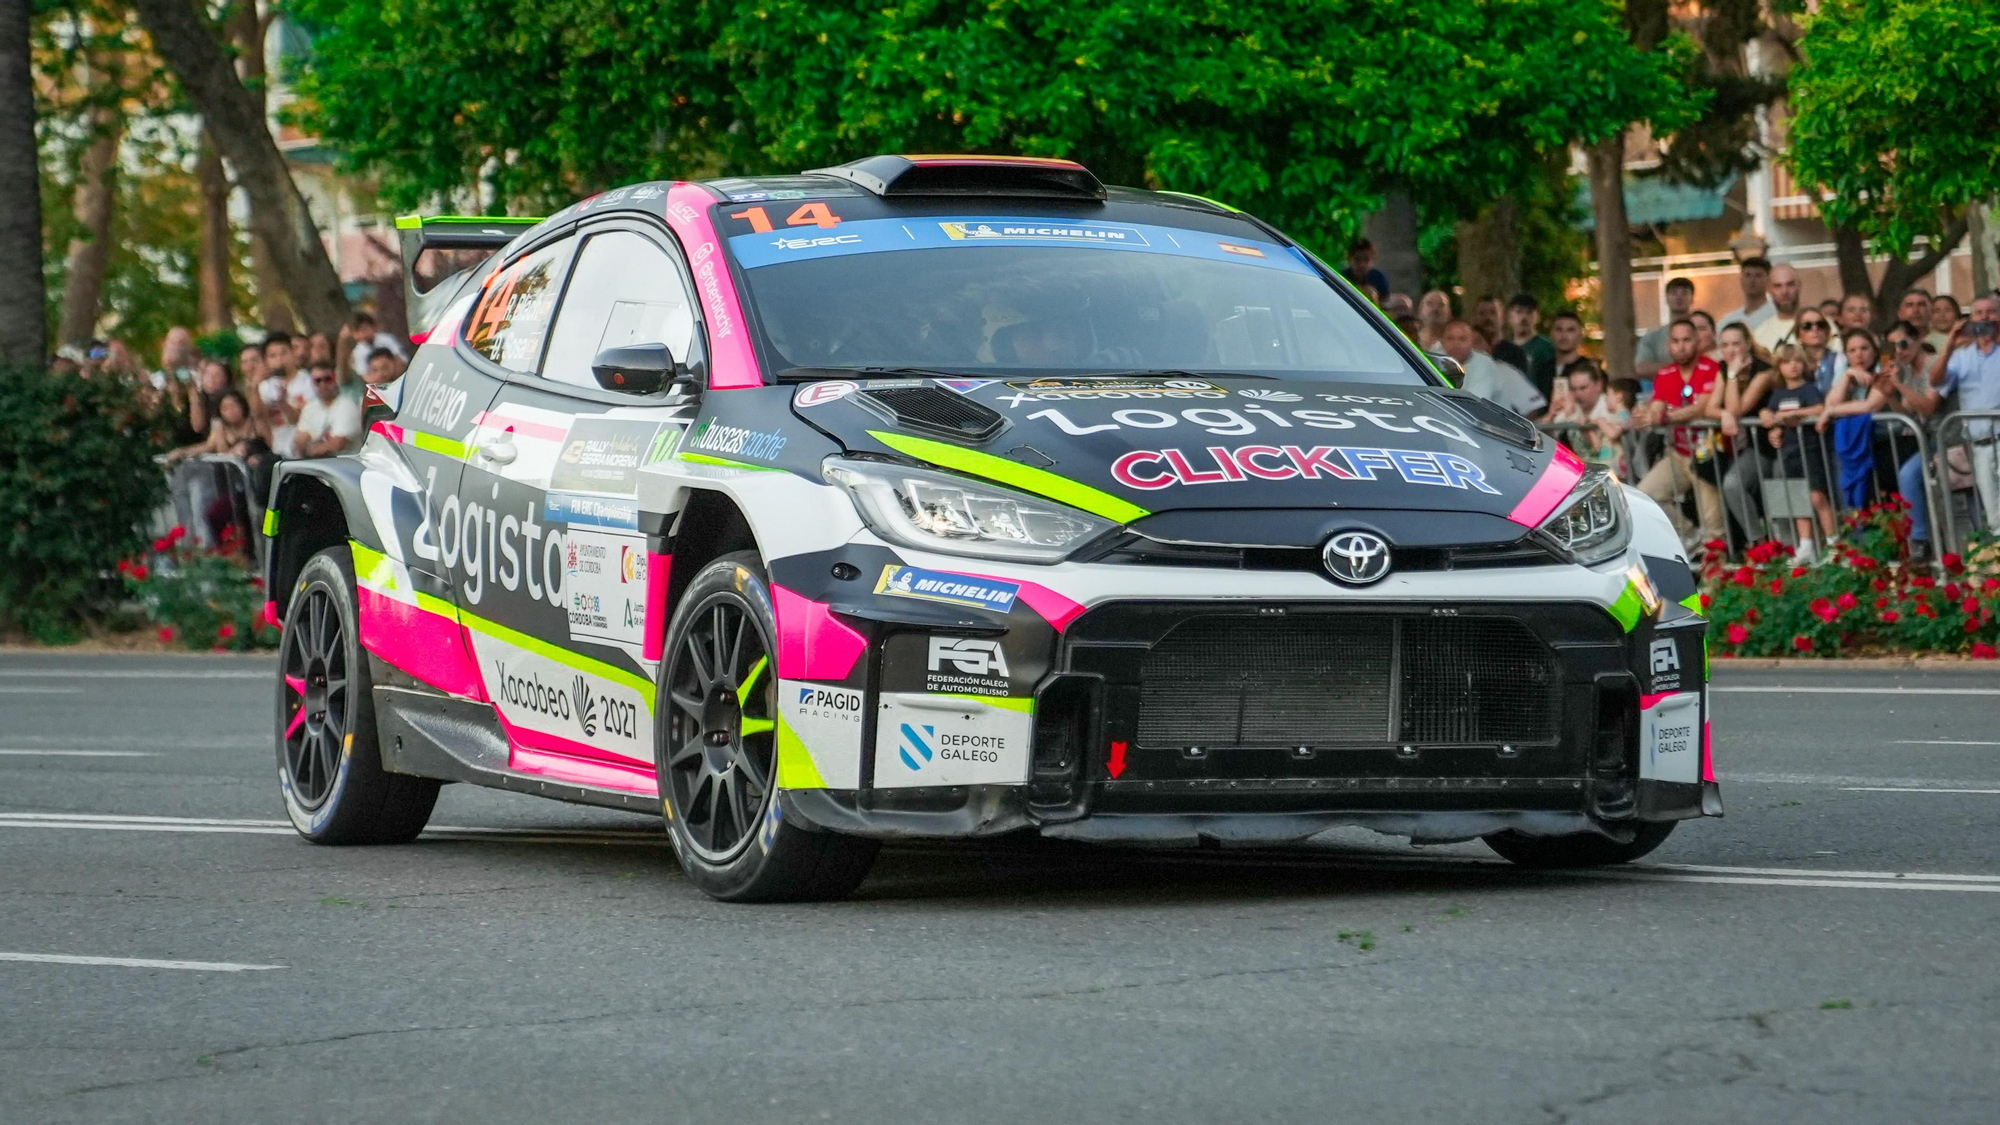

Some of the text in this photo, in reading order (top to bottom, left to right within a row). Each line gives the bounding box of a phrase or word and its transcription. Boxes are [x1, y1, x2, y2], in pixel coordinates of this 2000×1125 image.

[731, 203, 842, 233] 14
[1004, 227, 1125, 239] MICHELIN
[786, 234, 862, 250] ERC
[465, 255, 529, 341] 14
[405, 363, 467, 431] Arteixo
[809, 385, 844, 402] E
[996, 391, 1227, 409] Xacobeo
[584, 440, 610, 453] RALLY
[1110, 445, 1503, 496] CLICKFER
[914, 578, 1014, 604] MICHELIN
[926, 636, 1010, 678] FGA
[927, 674, 1009, 689] FEDERACIÓN GALEGA
[926, 683, 1009, 697] DE AUTOMOBILISMO
[496, 660, 637, 740] Xacobeo 2027
[817, 690, 860, 711] PAGID
[799, 708, 860, 723] RACING
[1659, 727, 1691, 740] DEPORTE
[941, 734, 1005, 750] DEPORTE
[1658, 740, 1687, 753] GALEGO
[940, 749, 998, 763] GALEGO
